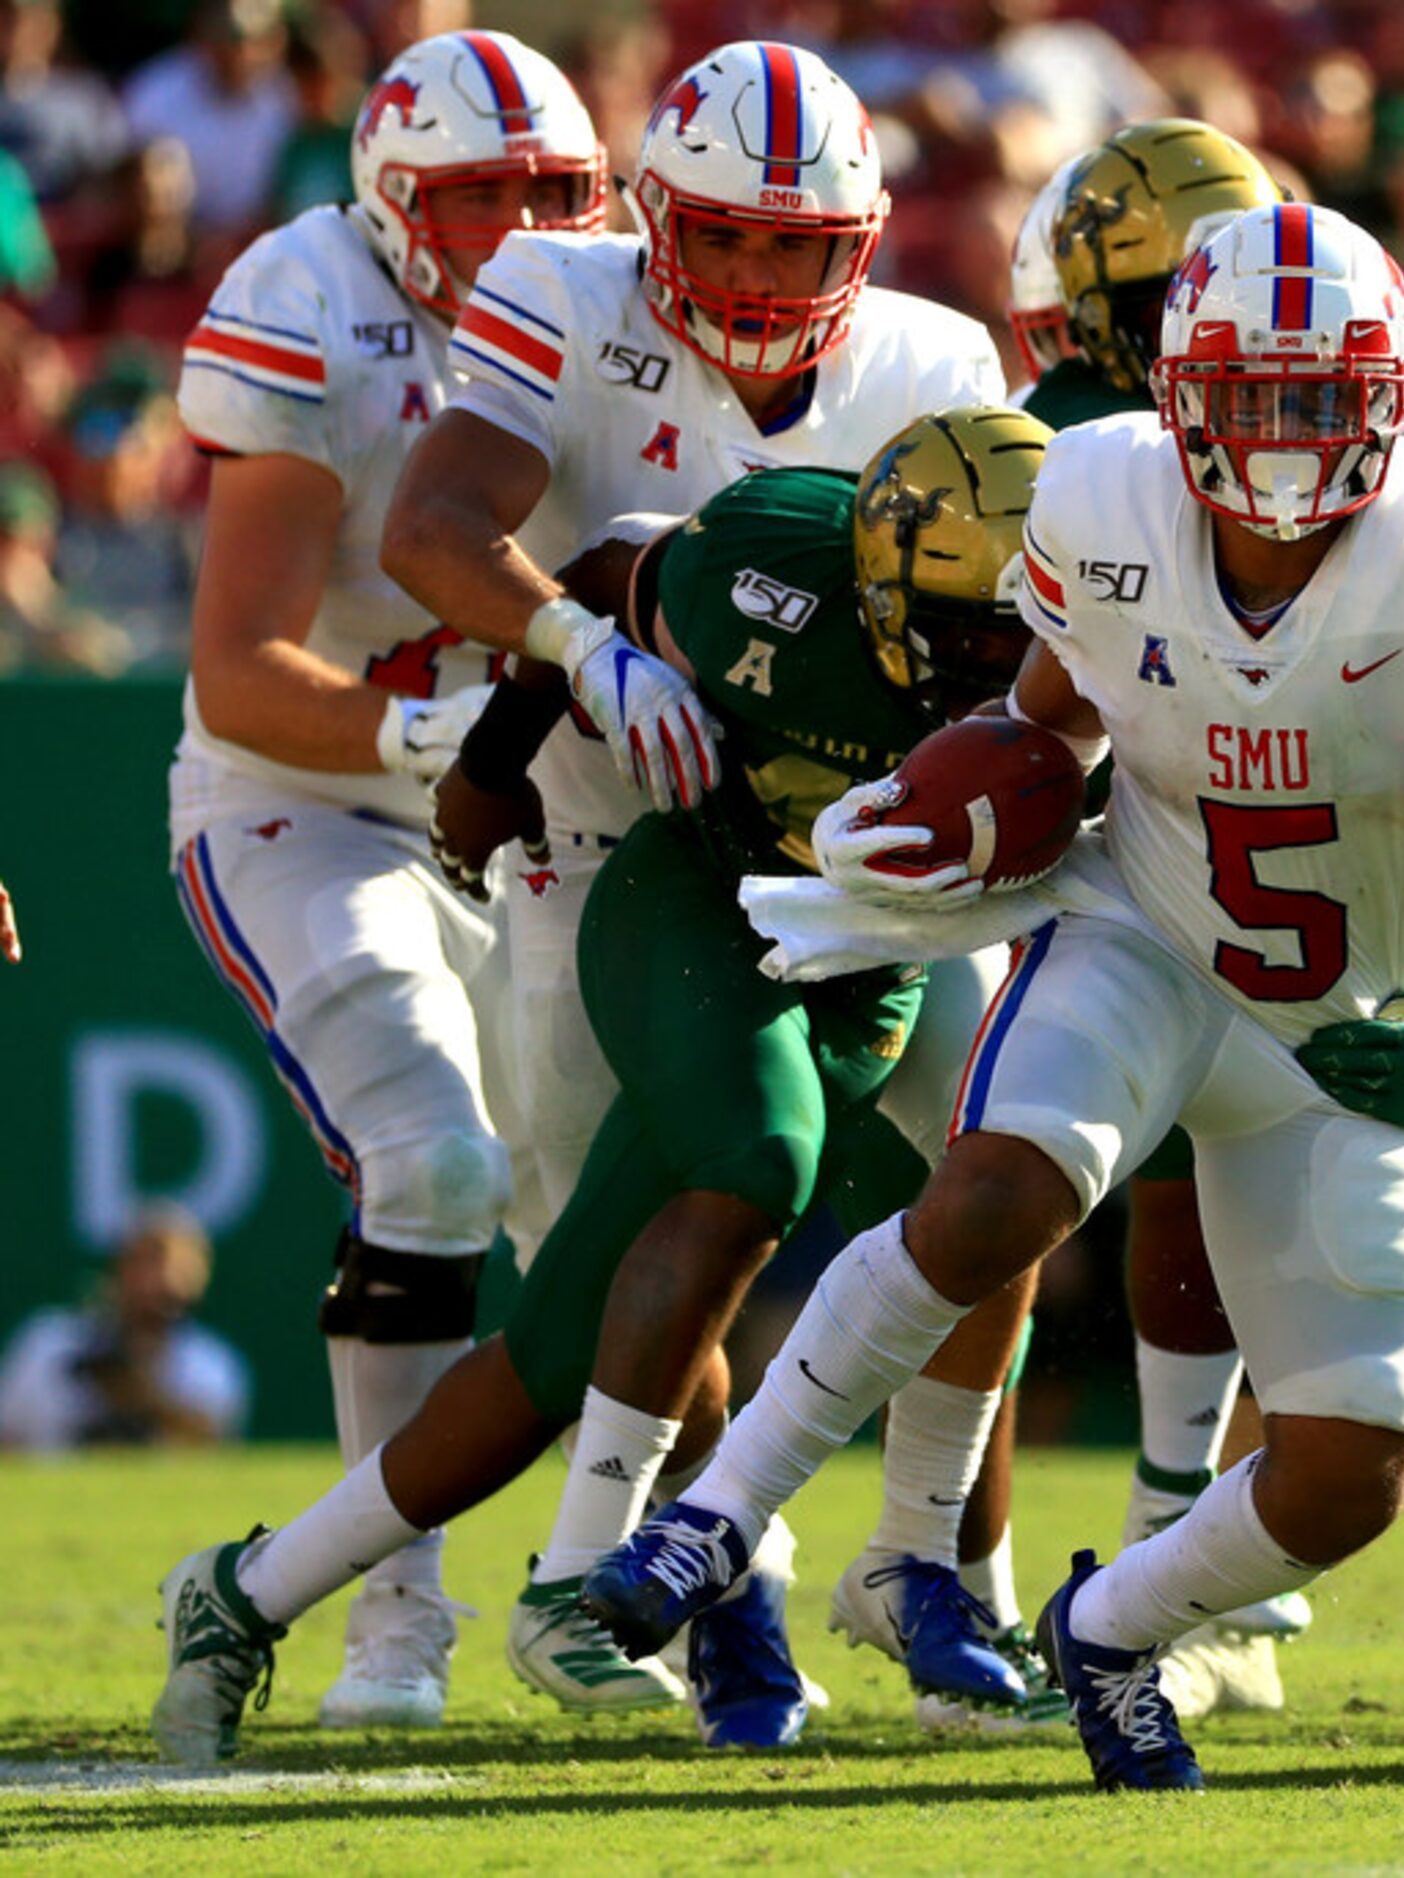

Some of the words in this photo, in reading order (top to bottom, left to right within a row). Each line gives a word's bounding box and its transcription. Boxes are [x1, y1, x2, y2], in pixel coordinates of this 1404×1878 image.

[759, 189, 803, 209] SMU
[352, 320, 414, 361] 150
[599, 341, 670, 393] 150
[400, 382, 430, 423] A
[640, 419, 681, 473] A
[738, 571, 817, 632] 150
[1078, 560, 1149, 603] 150
[725, 637, 776, 697] A
[1138, 633, 1177, 688] A
[1207, 723, 1309, 790] SMU
[1196, 795, 1349, 1003] 5
